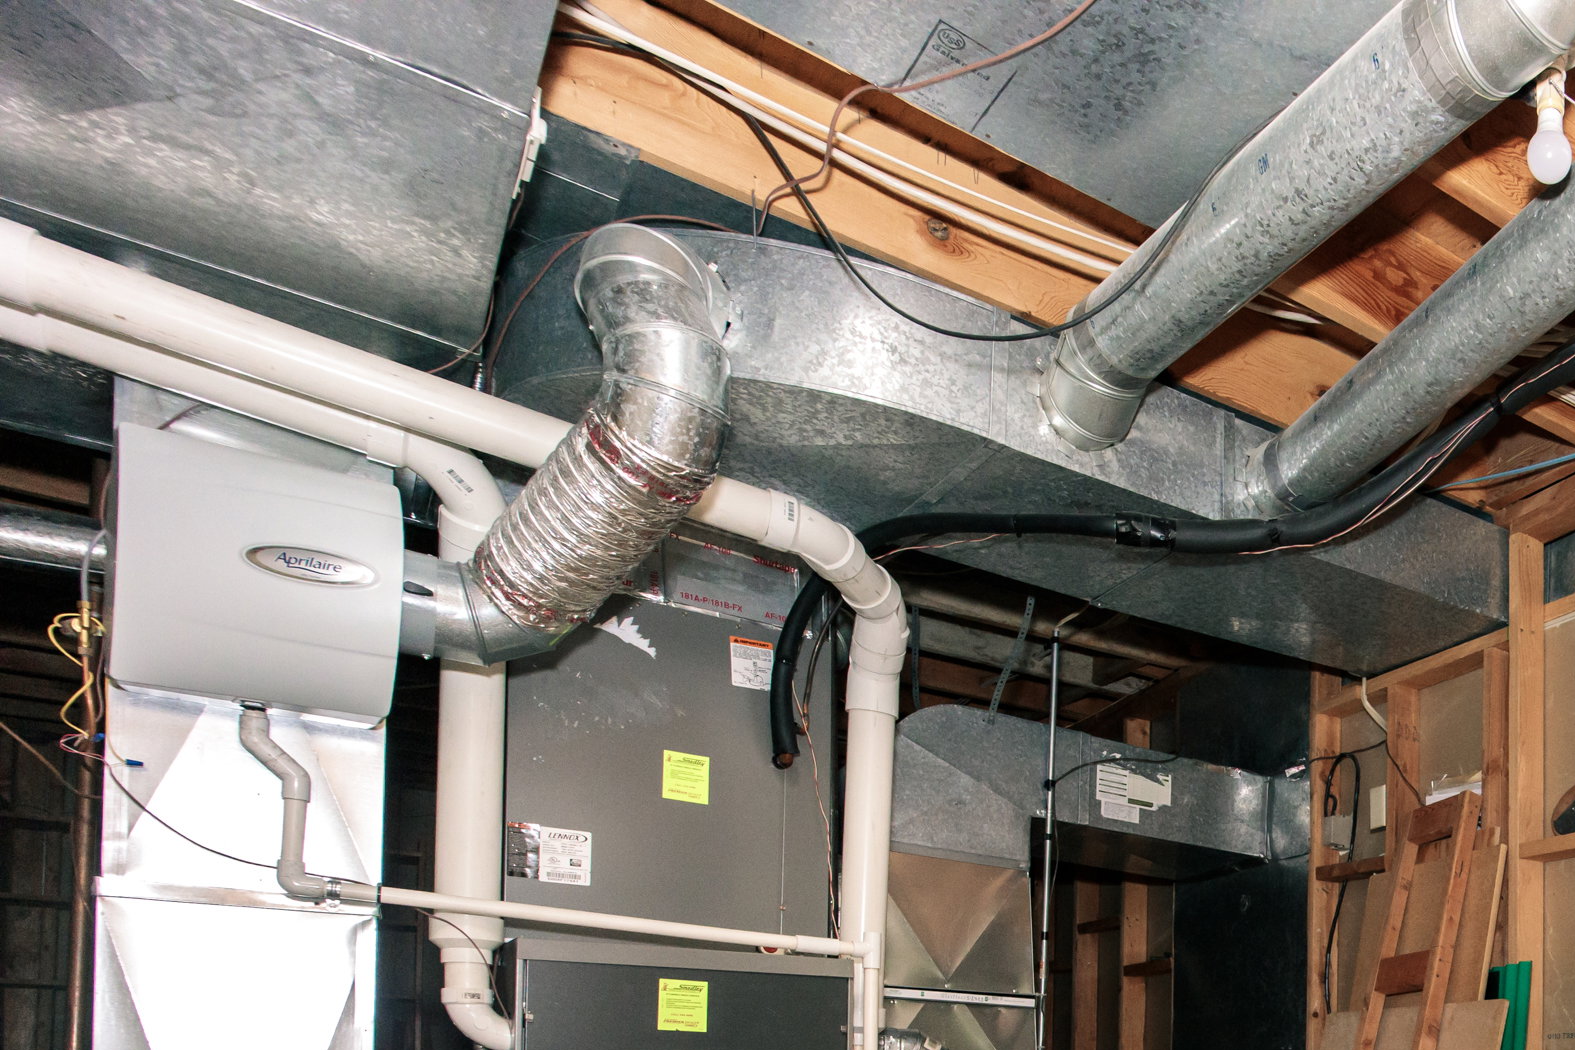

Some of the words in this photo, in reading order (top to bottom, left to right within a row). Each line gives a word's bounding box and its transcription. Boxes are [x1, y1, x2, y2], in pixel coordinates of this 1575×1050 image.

[275, 551, 343, 574] Aprilaire
[680, 590, 743, 613] 181A-P/181B-FX
[548, 832, 580, 841] LENNOX
